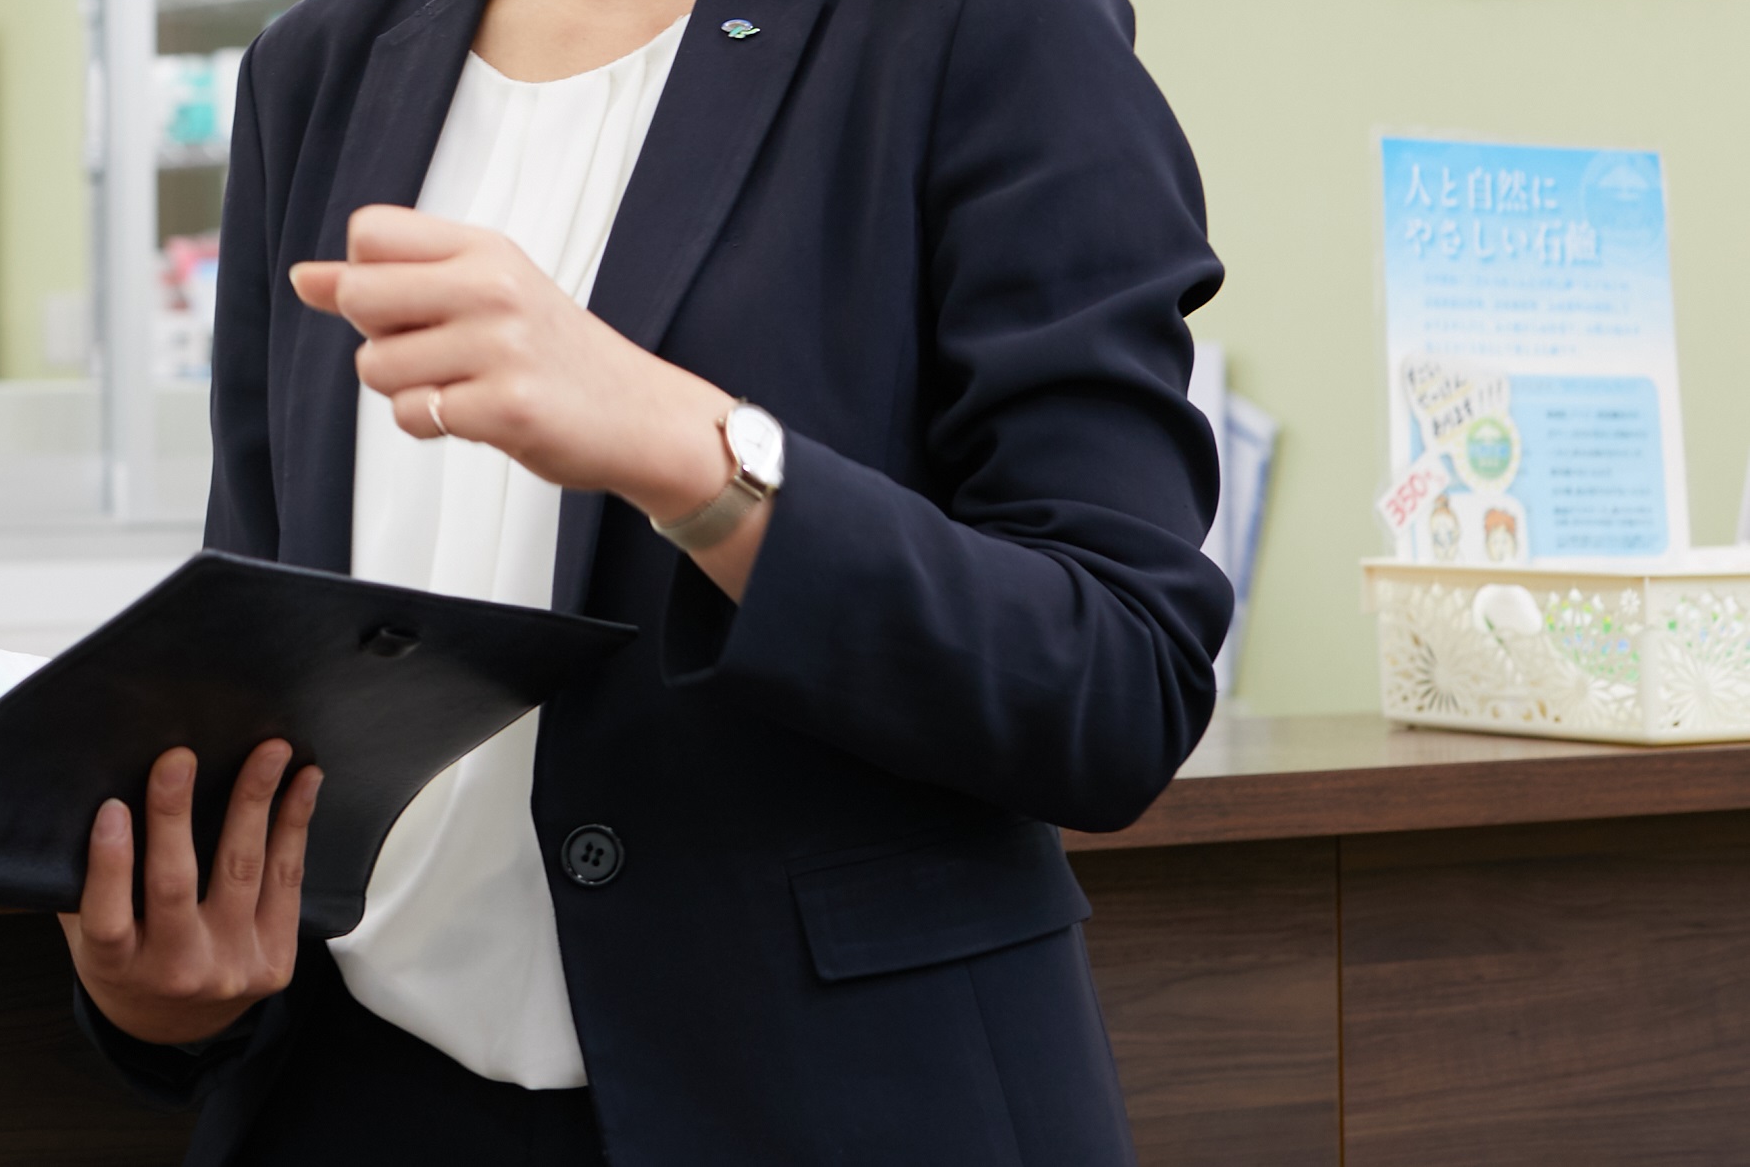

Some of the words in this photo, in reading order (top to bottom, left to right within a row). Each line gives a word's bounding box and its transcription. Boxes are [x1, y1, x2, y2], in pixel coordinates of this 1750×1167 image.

[1403, 162, 1559, 213] 人と自然に
